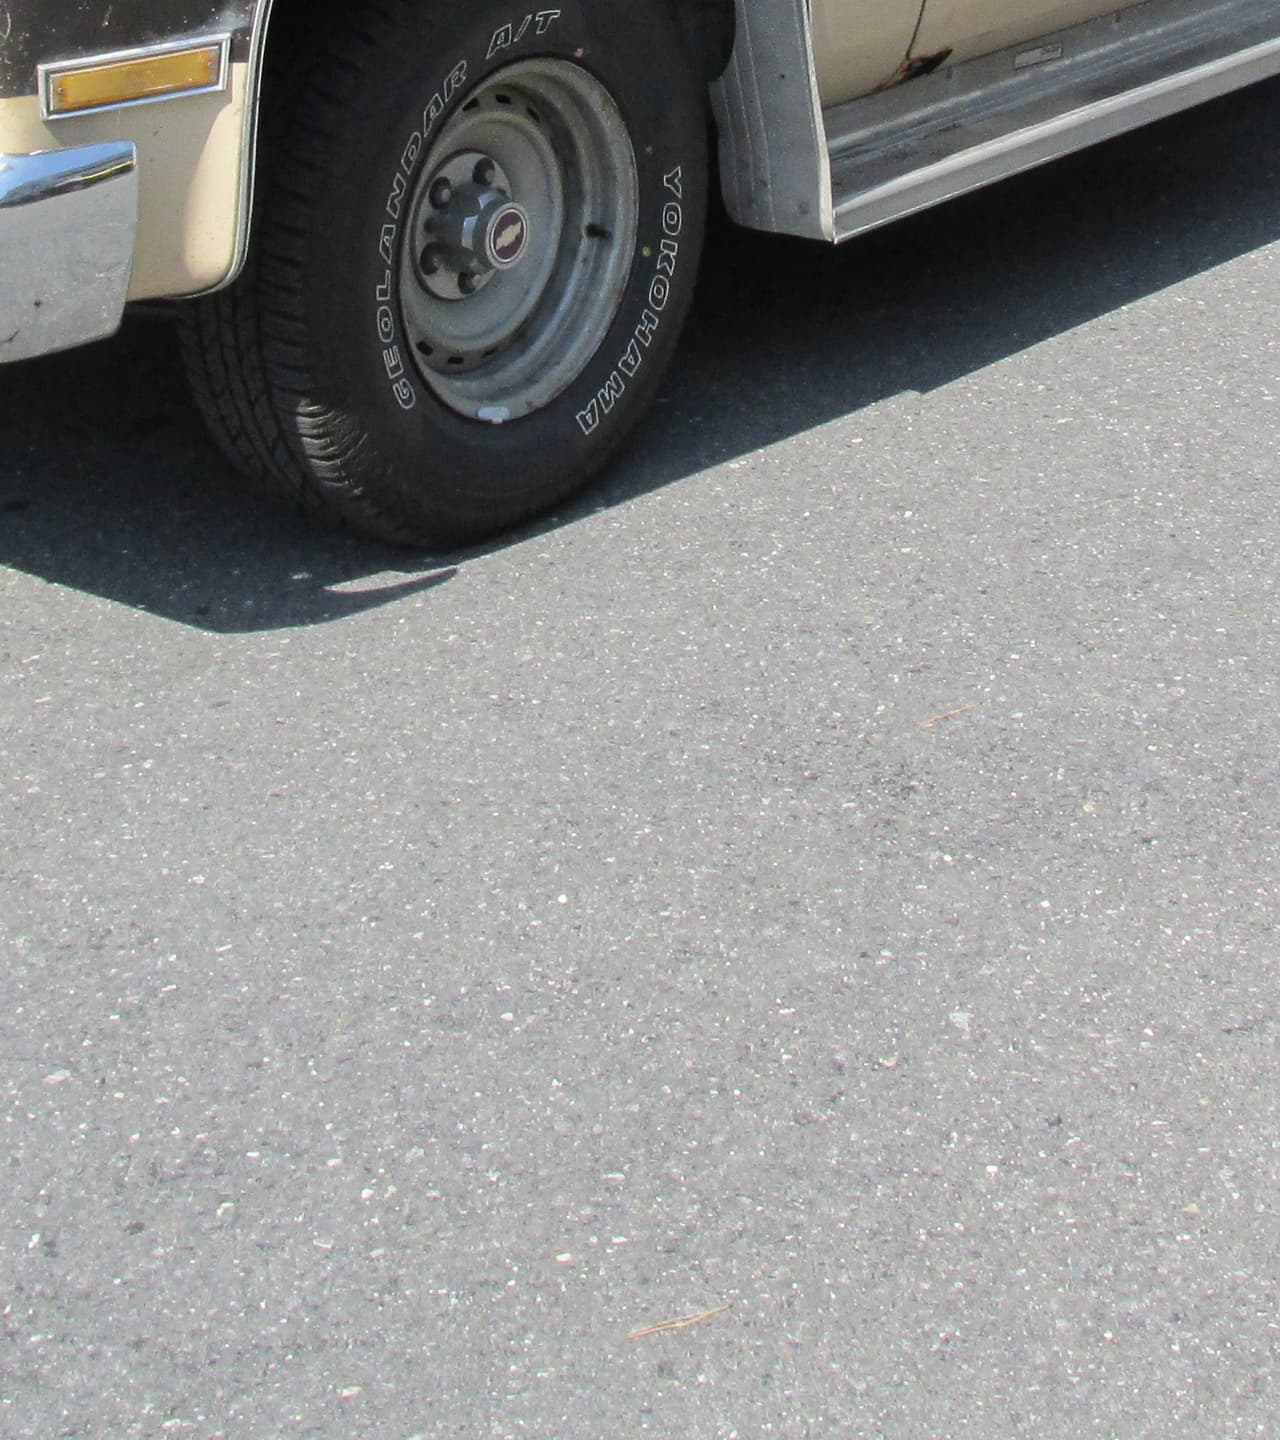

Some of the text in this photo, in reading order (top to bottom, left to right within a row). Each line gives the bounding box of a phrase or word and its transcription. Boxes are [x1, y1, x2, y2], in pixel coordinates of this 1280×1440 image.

[376, 9, 561, 410] GEOLANDAR A/T
[576, 166, 683, 436] YOKOHAMA
